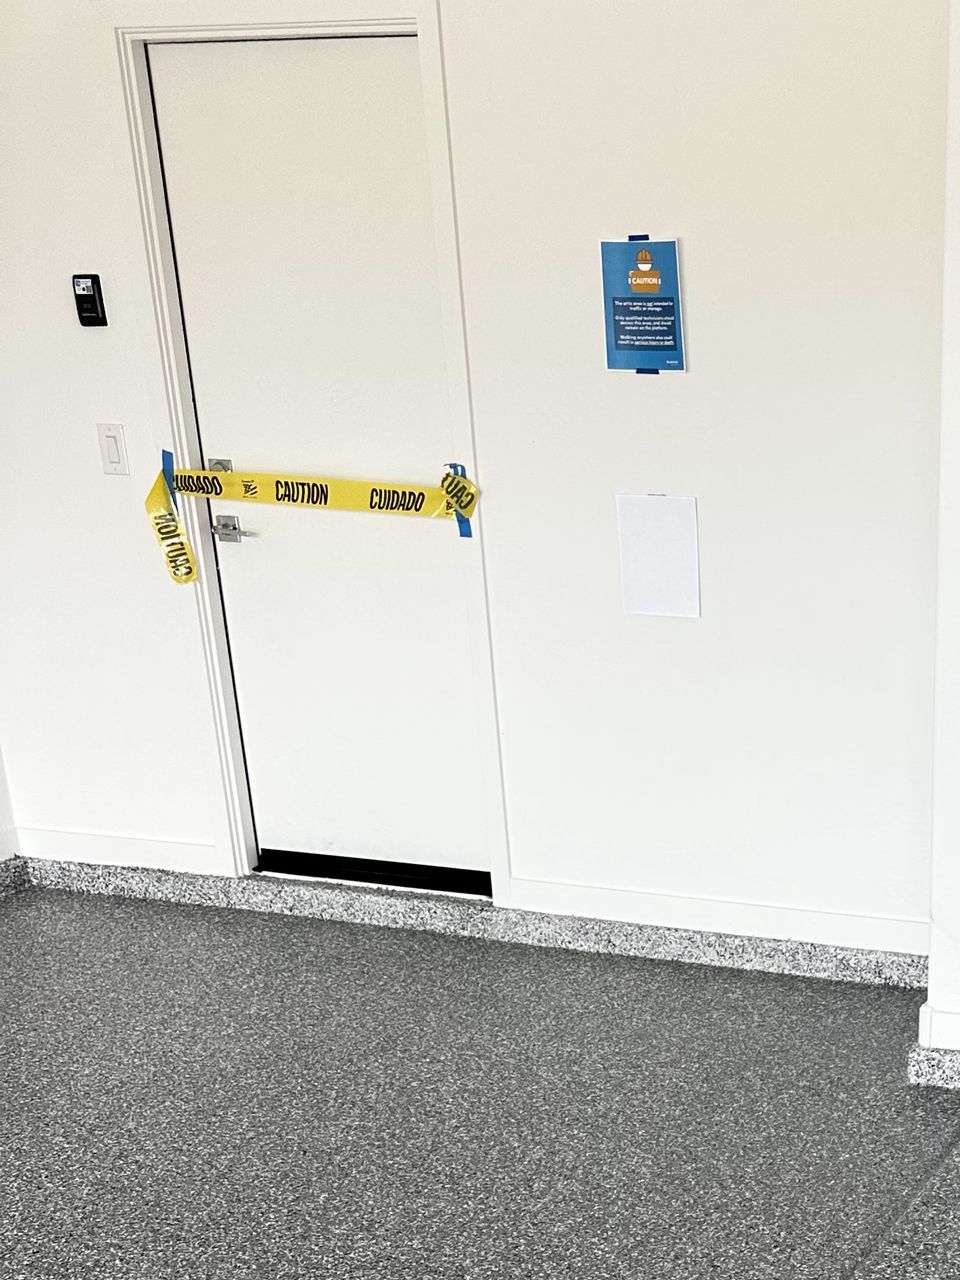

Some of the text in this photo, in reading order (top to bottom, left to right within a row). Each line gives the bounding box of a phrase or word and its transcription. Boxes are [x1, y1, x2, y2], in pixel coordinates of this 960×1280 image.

[632, 277, 658, 285] CAUTION
[172, 475, 223, 496] UIDADO
[275, 480, 328, 506] CAUTION
[369, 488, 425, 512] CUIDADO
